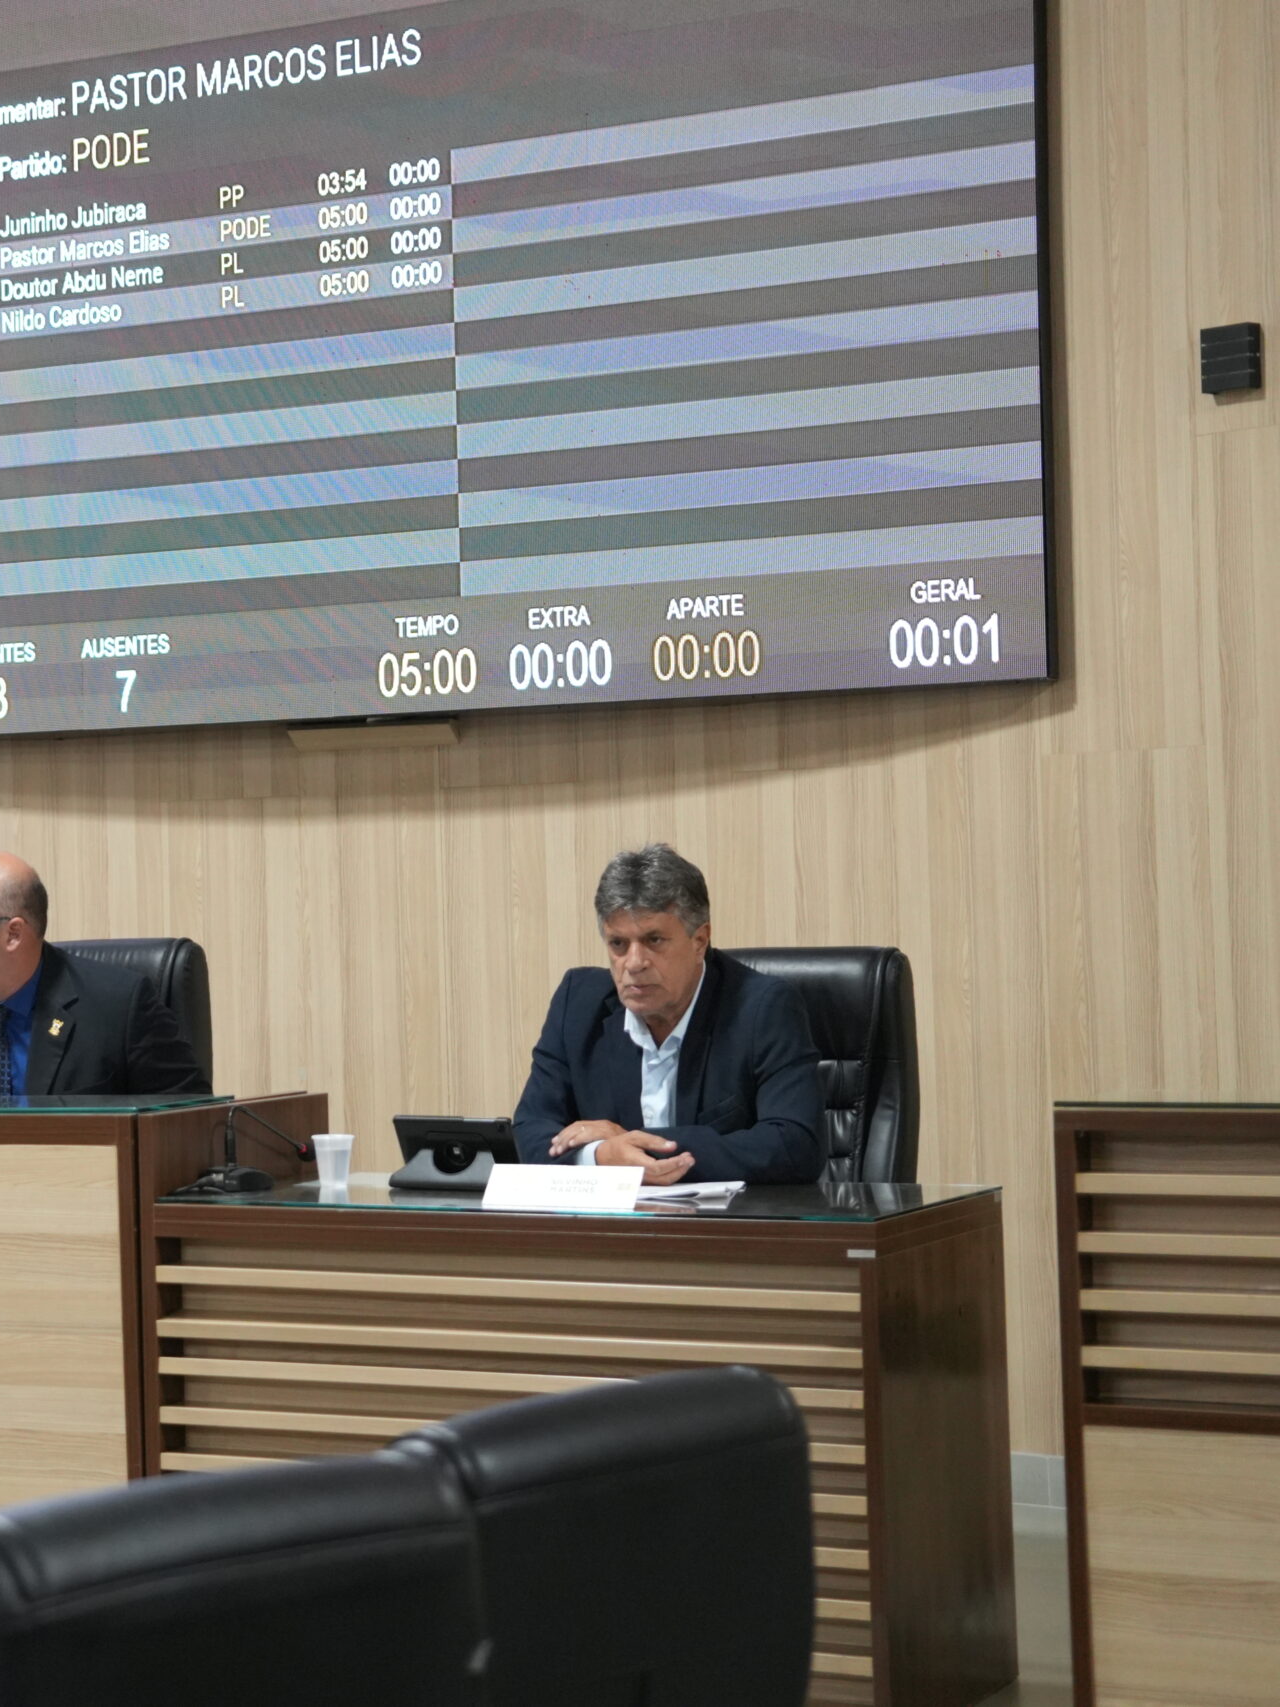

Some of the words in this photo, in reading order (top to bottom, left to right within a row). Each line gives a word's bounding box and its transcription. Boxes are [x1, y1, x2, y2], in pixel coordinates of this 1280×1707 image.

[72, 66, 188, 116] PASTOR
[196, 44, 327, 98] MARCOS
[336, 28, 422, 77] ELIAS
[72, 128, 151, 172] PODE
[0, 208, 68, 238] Juninho
[71, 202, 147, 229] Jubiraca
[220, 184, 245, 209] PP
[318, 168, 367, 196] 03:54
[389, 157, 441, 187] 00:00
[0, 243, 56, 270] Pastor
[60, 237, 125, 263] Marcos
[129, 229, 171, 255] Elias
[220, 214, 271, 243] PODE
[318, 201, 368, 230] 05:00
[389, 191, 442, 220] 00:00
[0, 276, 58, 302] Doutor
[62, 268, 107, 295] Abdu
[111, 264, 164, 289] Neme
[221, 252, 245, 276] PL
[319, 235, 369, 264] 05:00
[390, 226, 442, 254] 00:00
[1, 307, 46, 334] Nildo
[49, 301, 122, 328] Cardoso
[221, 286, 245, 309] PL
[319, 269, 370, 297] 05:00
[391, 260, 443, 289] 00:00
[666, 593, 745, 621] APARTE
[910, 577, 982, 604] GERAL
[395, 613, 460, 638] TEMPO
[528, 605, 591, 630] EXTRA
[889, 612, 1000, 669] 00:01
[80, 633, 170, 660] AUSENTES
[378, 647, 478, 698] 05:00
[509, 638, 613, 691] 00:00
[653, 629, 761, 682] 00:00
[115, 670, 137, 714] 7
